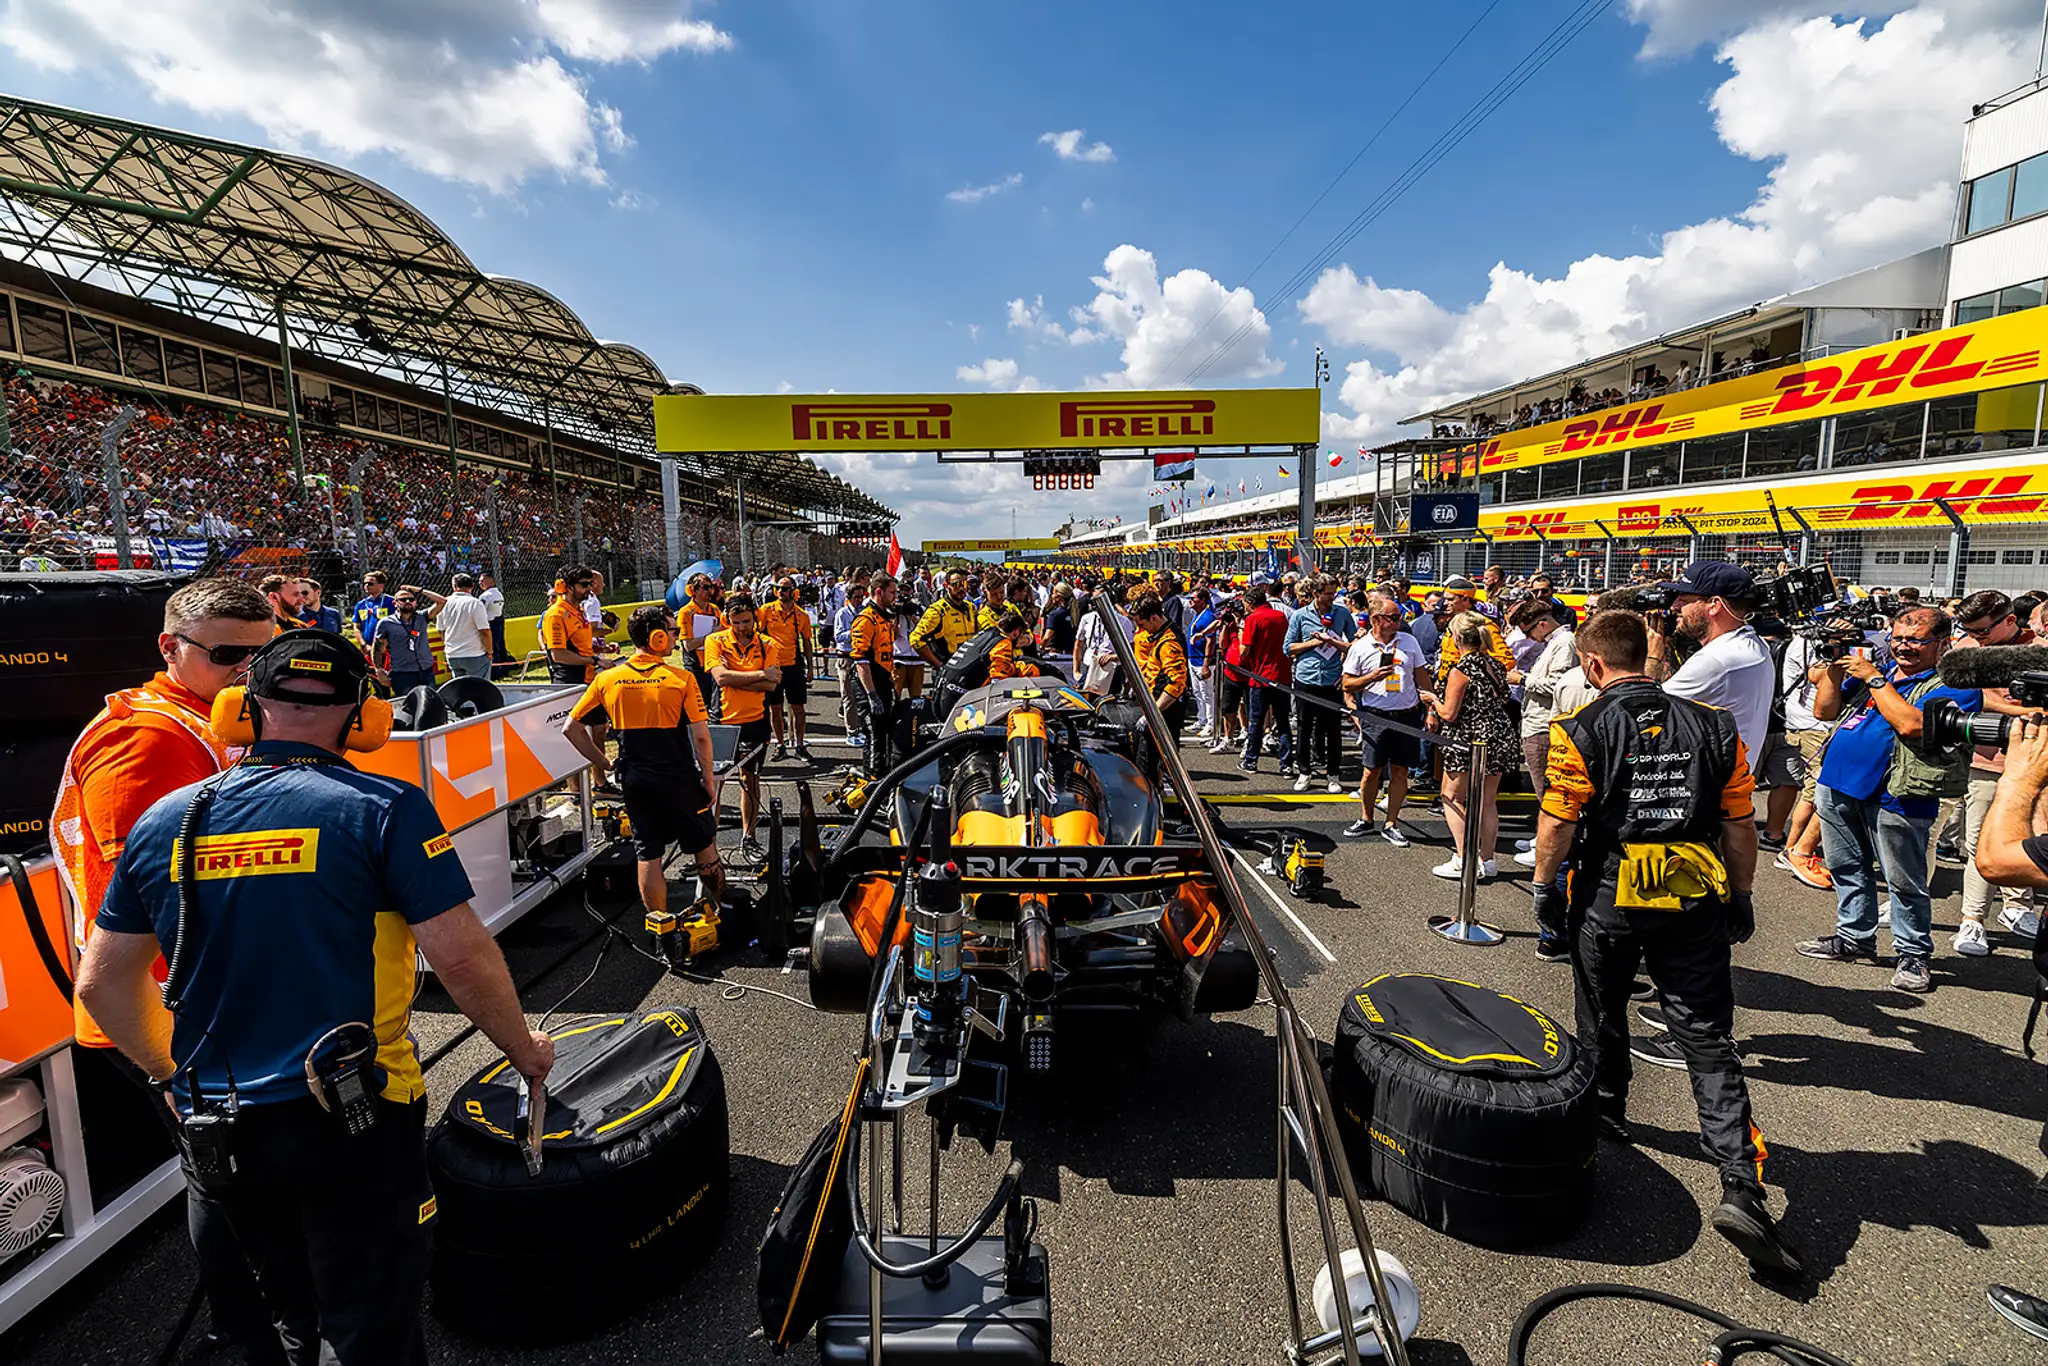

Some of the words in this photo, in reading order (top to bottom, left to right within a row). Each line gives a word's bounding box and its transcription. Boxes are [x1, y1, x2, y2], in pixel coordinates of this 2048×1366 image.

[1770, 334, 1988, 415] DHL
[792, 404, 953, 440] PIRELLI
[1060, 400, 1216, 437] PIRELLI
[1560, 404, 1671, 452] DHL
[1847, 475, 2046, 520] DHL
[1433, 507, 1456, 520] FIA
[1504, 512, 1571, 536] DHL
[1662, 518, 1699, 529] FASTT
[1699, 519, 1715, 528] PIT
[1716, 518, 1741, 528] STOP
[1742, 517, 1768, 526] 2024
[55, 652, 68, 662] 4
[1653, 752, 1691, 763] WORLD
[1632, 771, 1667, 780] Android
[966, 855, 1179, 878] RKTRACE
[1397, 1144, 1406, 1156] 4
[667, 1189, 702, 1226] LANDO
